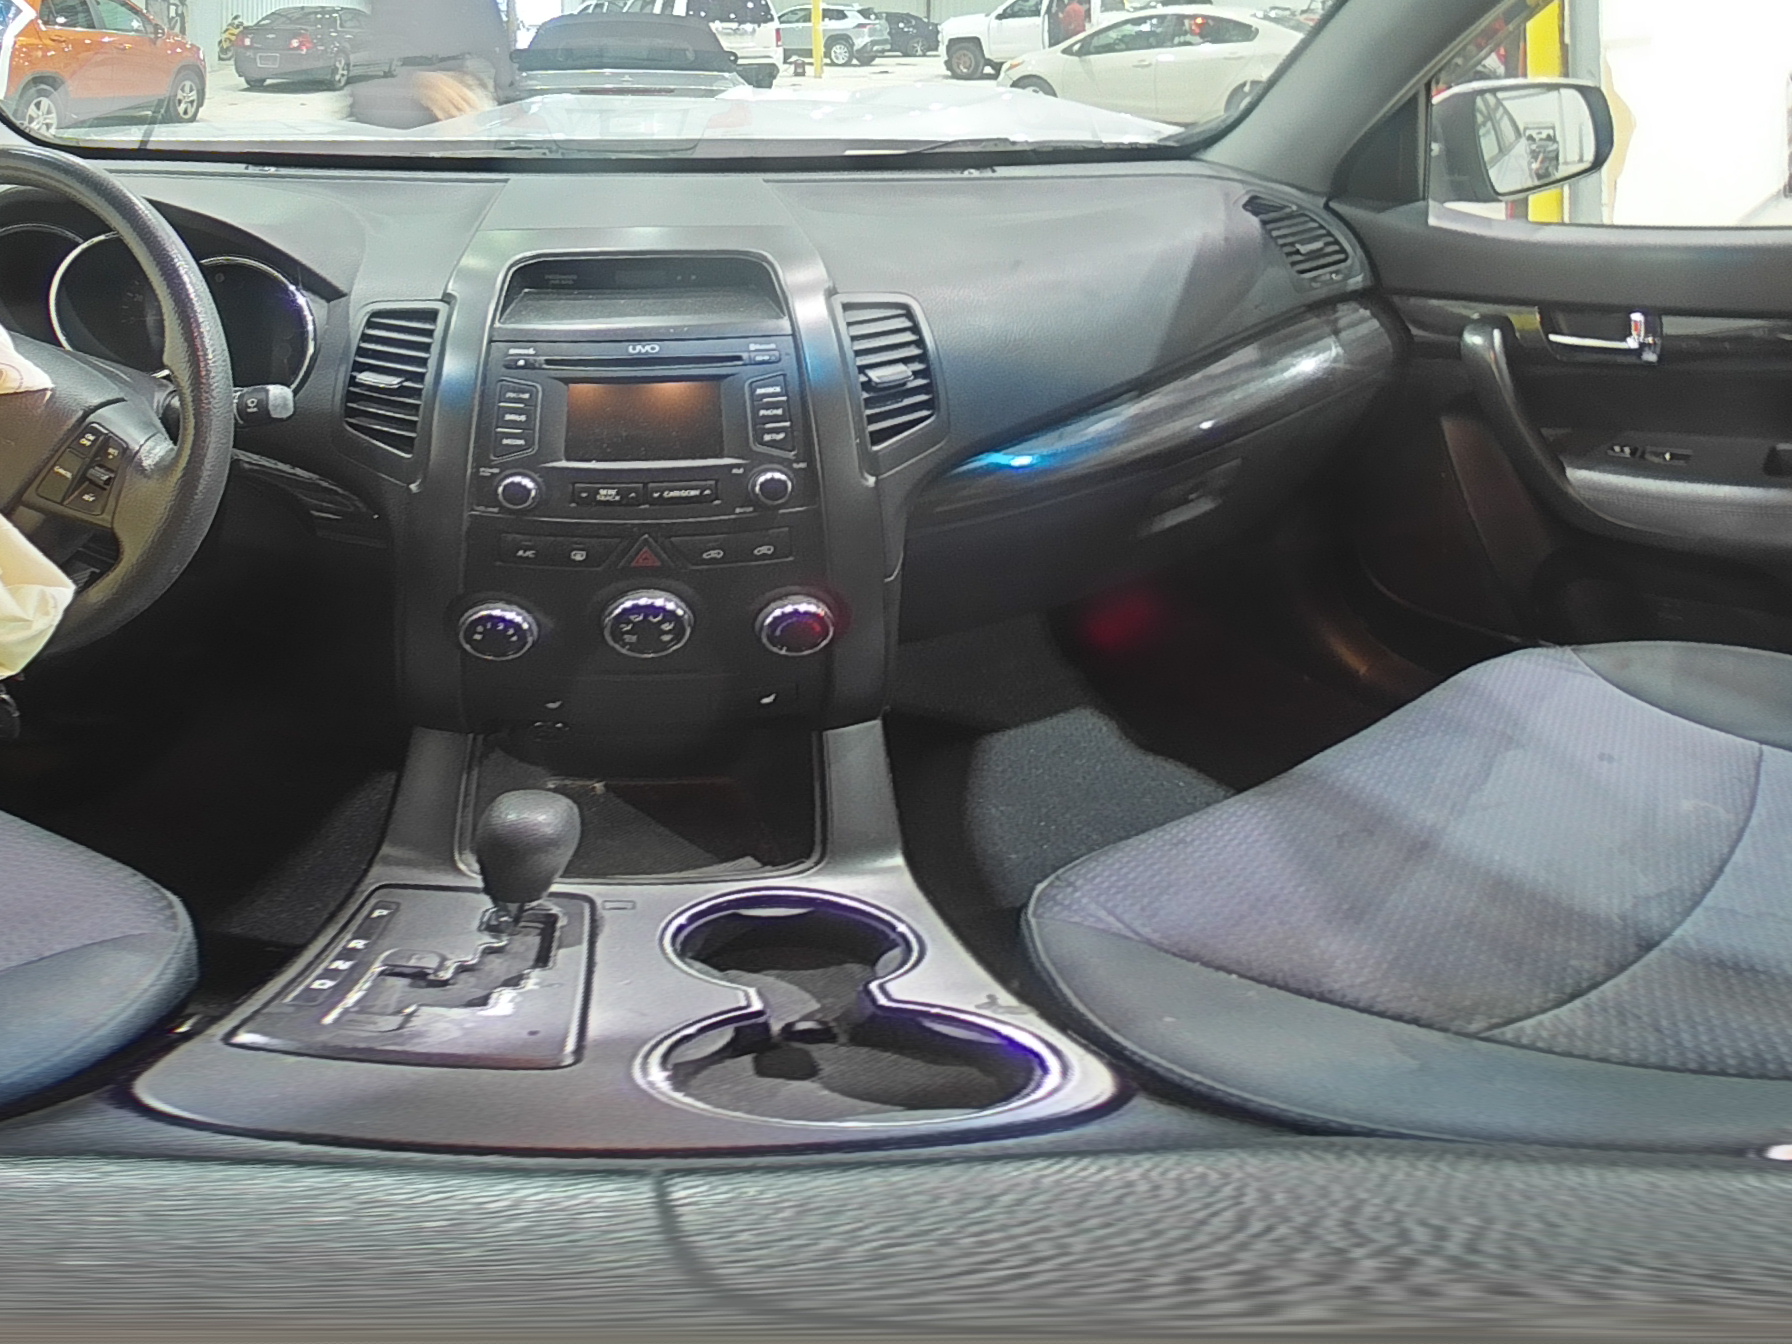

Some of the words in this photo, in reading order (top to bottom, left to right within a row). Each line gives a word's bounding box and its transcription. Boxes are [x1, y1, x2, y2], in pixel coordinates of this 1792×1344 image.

[628, 344, 660, 354] UVO
[369, 909, 393, 918] P
[346, 939, 370, 949] R
[328, 960, 355, 970] N
[309, 979, 337, 989] D
